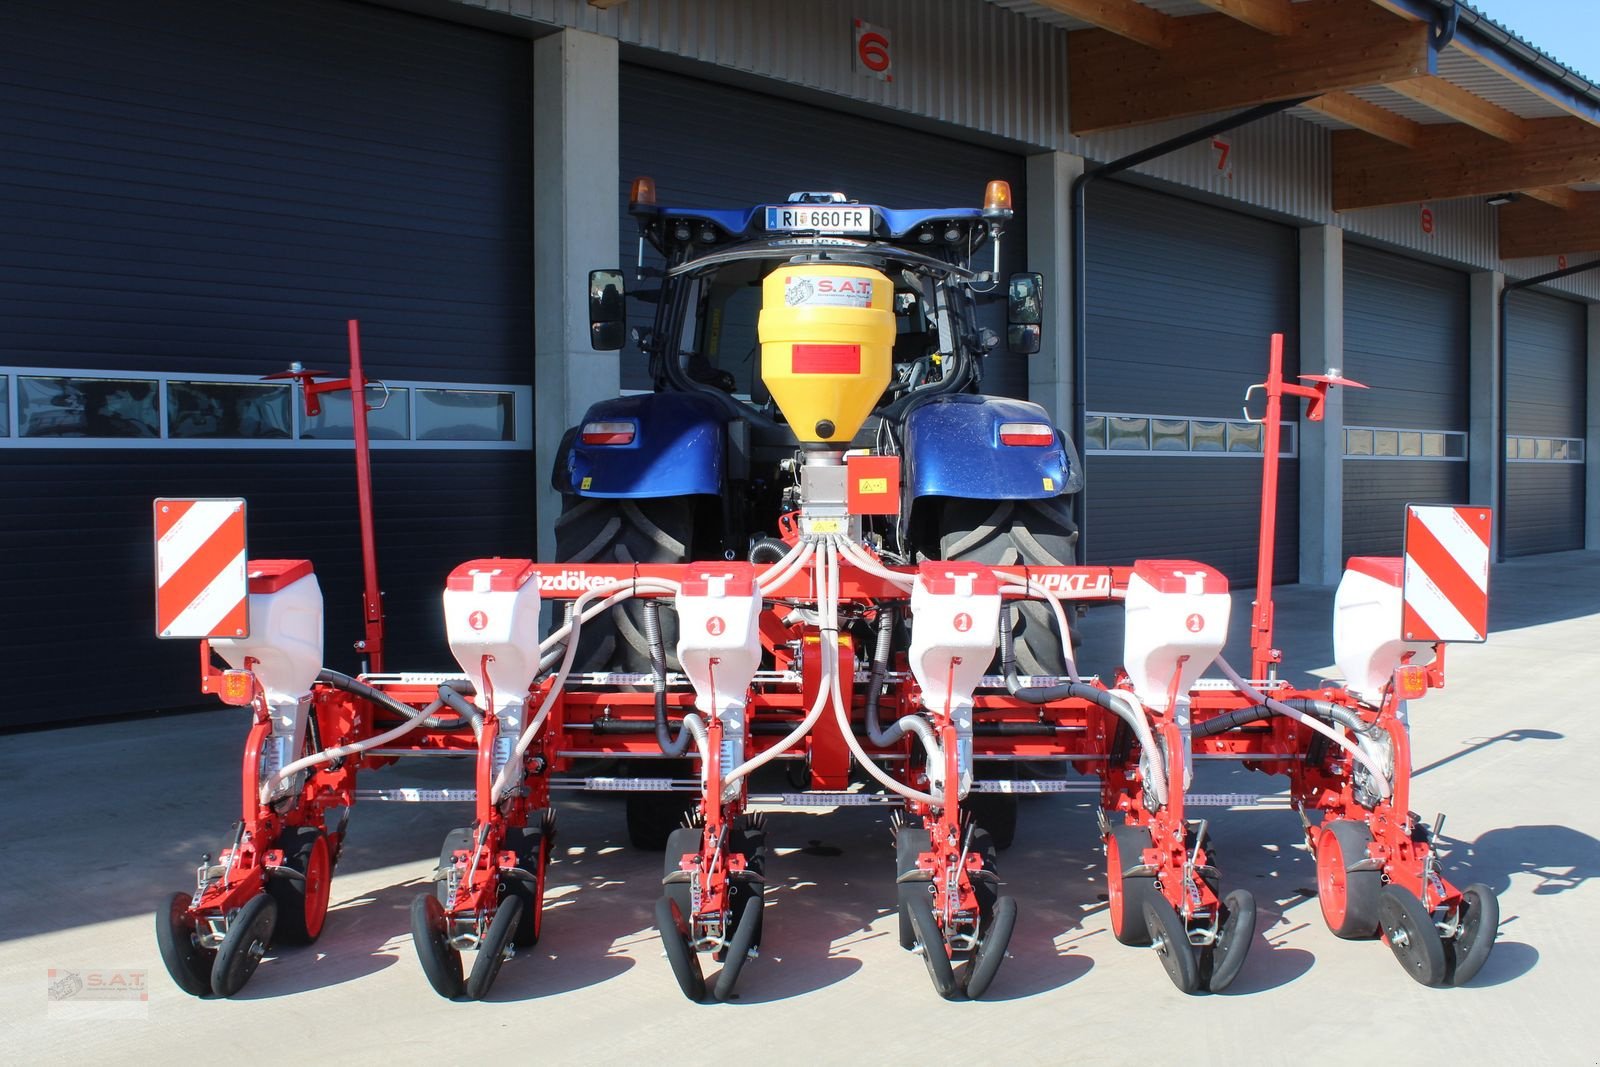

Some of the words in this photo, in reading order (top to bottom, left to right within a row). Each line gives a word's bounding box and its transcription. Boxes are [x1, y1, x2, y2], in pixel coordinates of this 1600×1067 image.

[858, 32, 889, 72] 6
[1213, 139, 1230, 170] 7
[783, 211, 798, 227] RI
[811, 211, 840, 227] 660
[843, 211, 863, 227] FR
[1421, 208, 1433, 233] 8
[817, 280, 871, 295] S.A.T.
